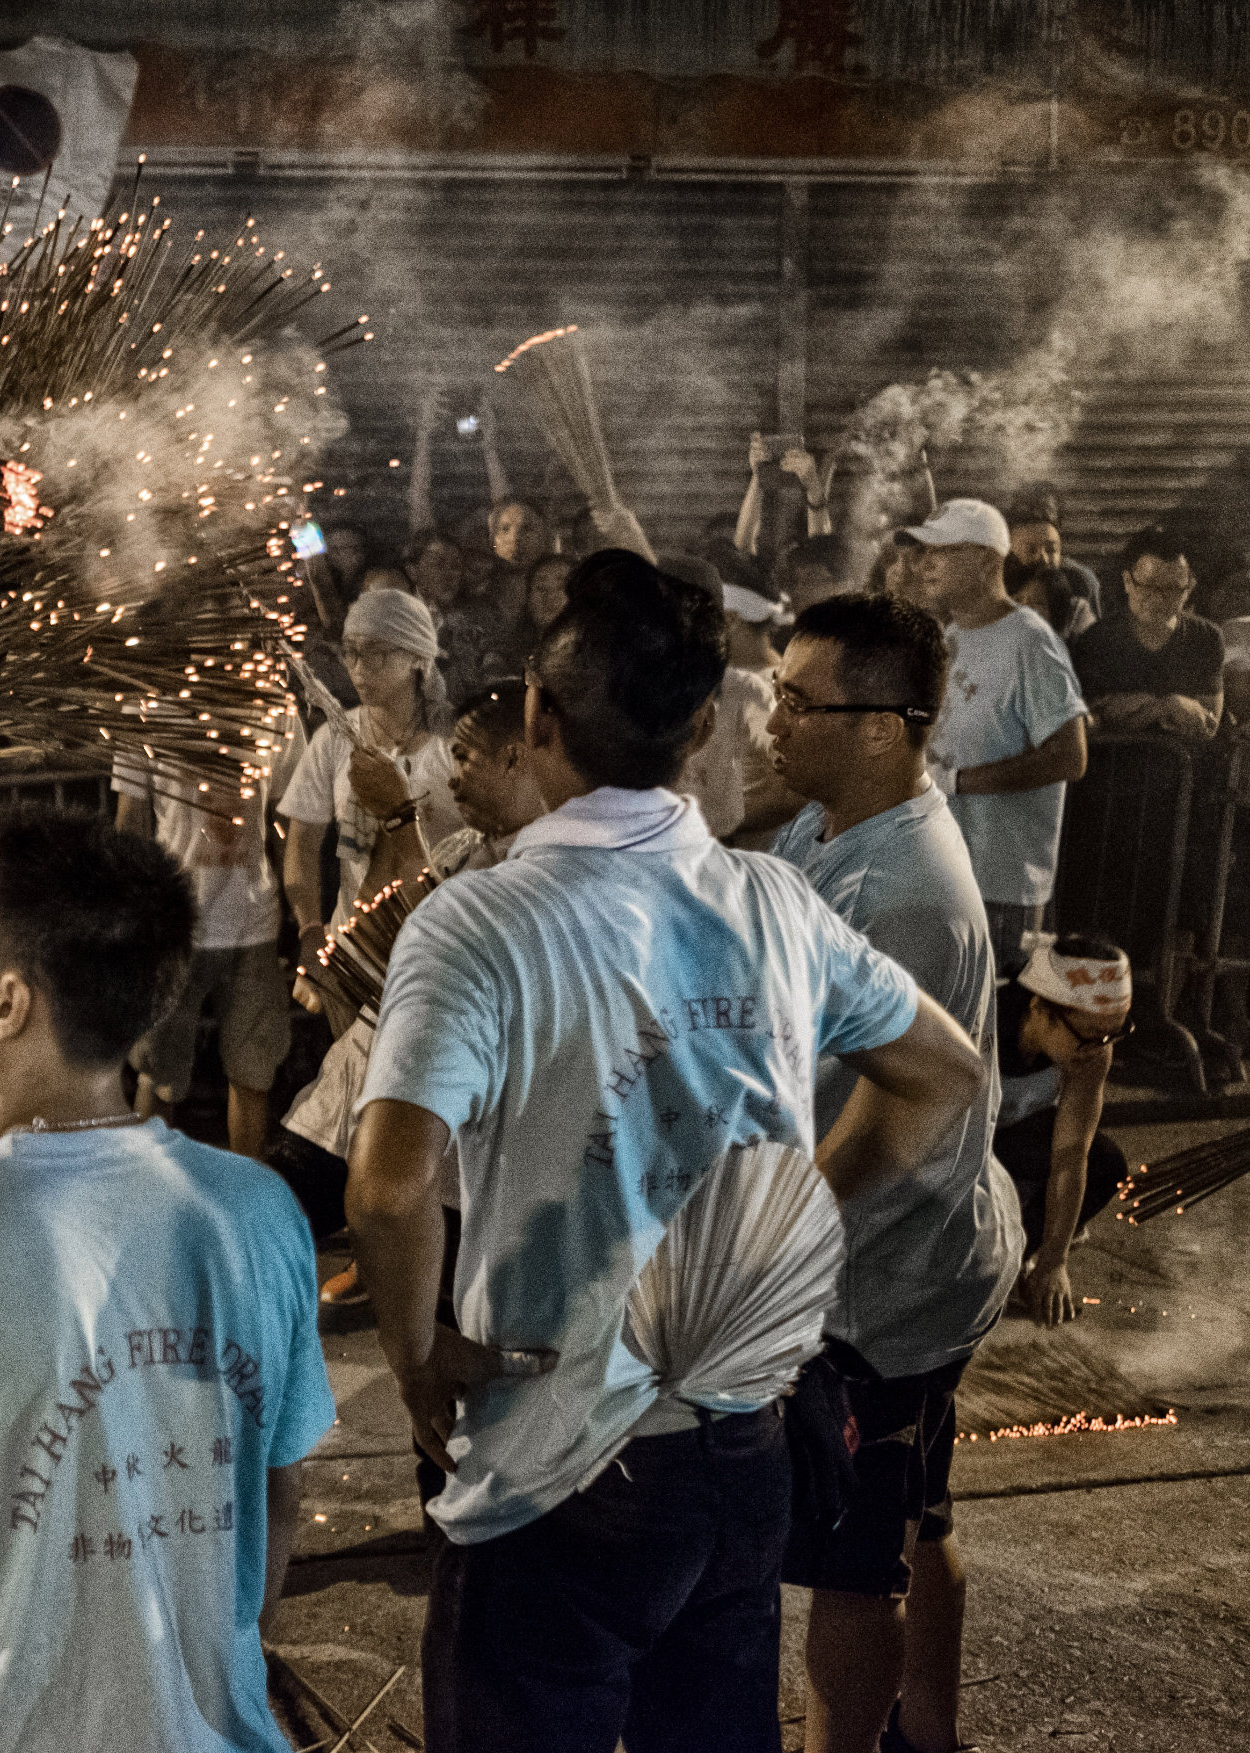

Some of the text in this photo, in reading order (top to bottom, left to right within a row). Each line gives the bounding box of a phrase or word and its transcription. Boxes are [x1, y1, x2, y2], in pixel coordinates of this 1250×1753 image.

[10, 1466, 51, 1533] TAI
[33, 1345, 115, 1467] HANG
[125, 1327, 210, 1369] FIRE
